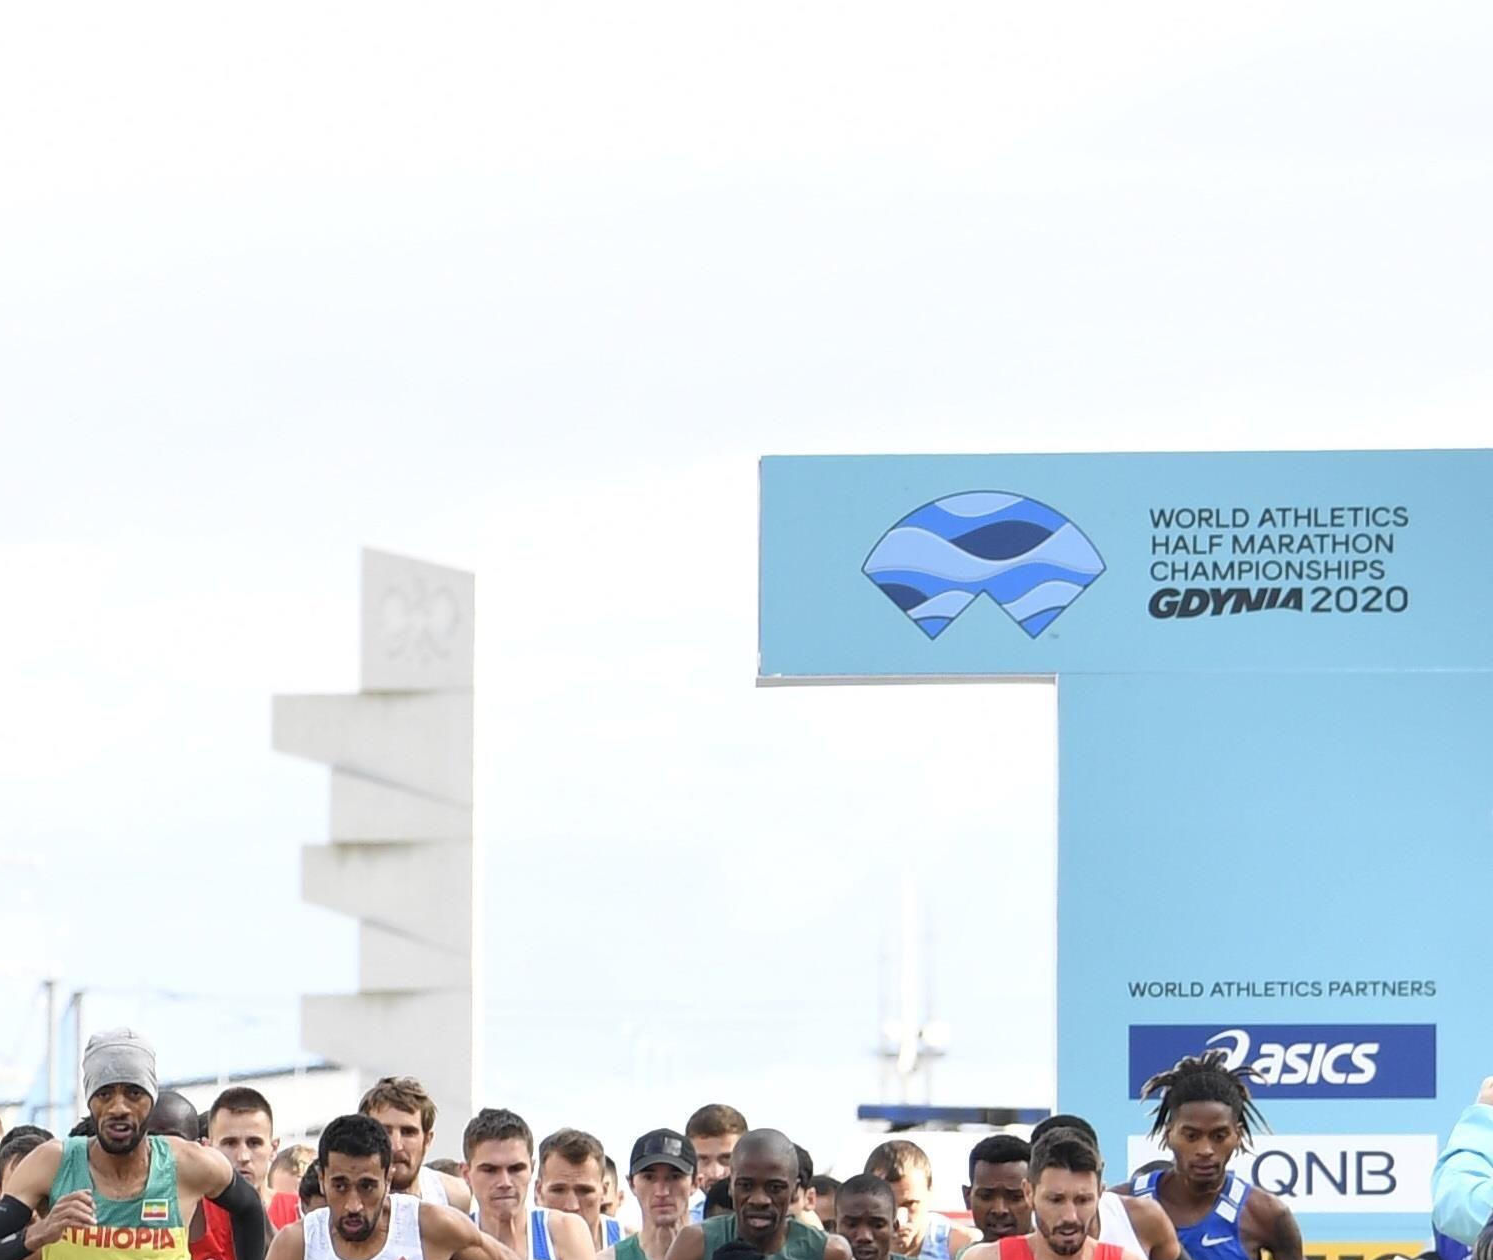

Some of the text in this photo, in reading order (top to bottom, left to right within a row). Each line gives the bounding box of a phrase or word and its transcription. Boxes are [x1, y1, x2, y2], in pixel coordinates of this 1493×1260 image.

[1148, 506, 1409, 529] WORLD ATHLETICS
[1151, 533, 1394, 556] HALF MARATHON
[1149, 559, 1386, 582] CHAMPIONSHIPS
[1148, 585, 1409, 620] GDYNIA 2020
[1128, 980, 1437, 998] WORLD ATHLETICS PARTNERS
[1251, 1150, 1398, 1198] QNB
